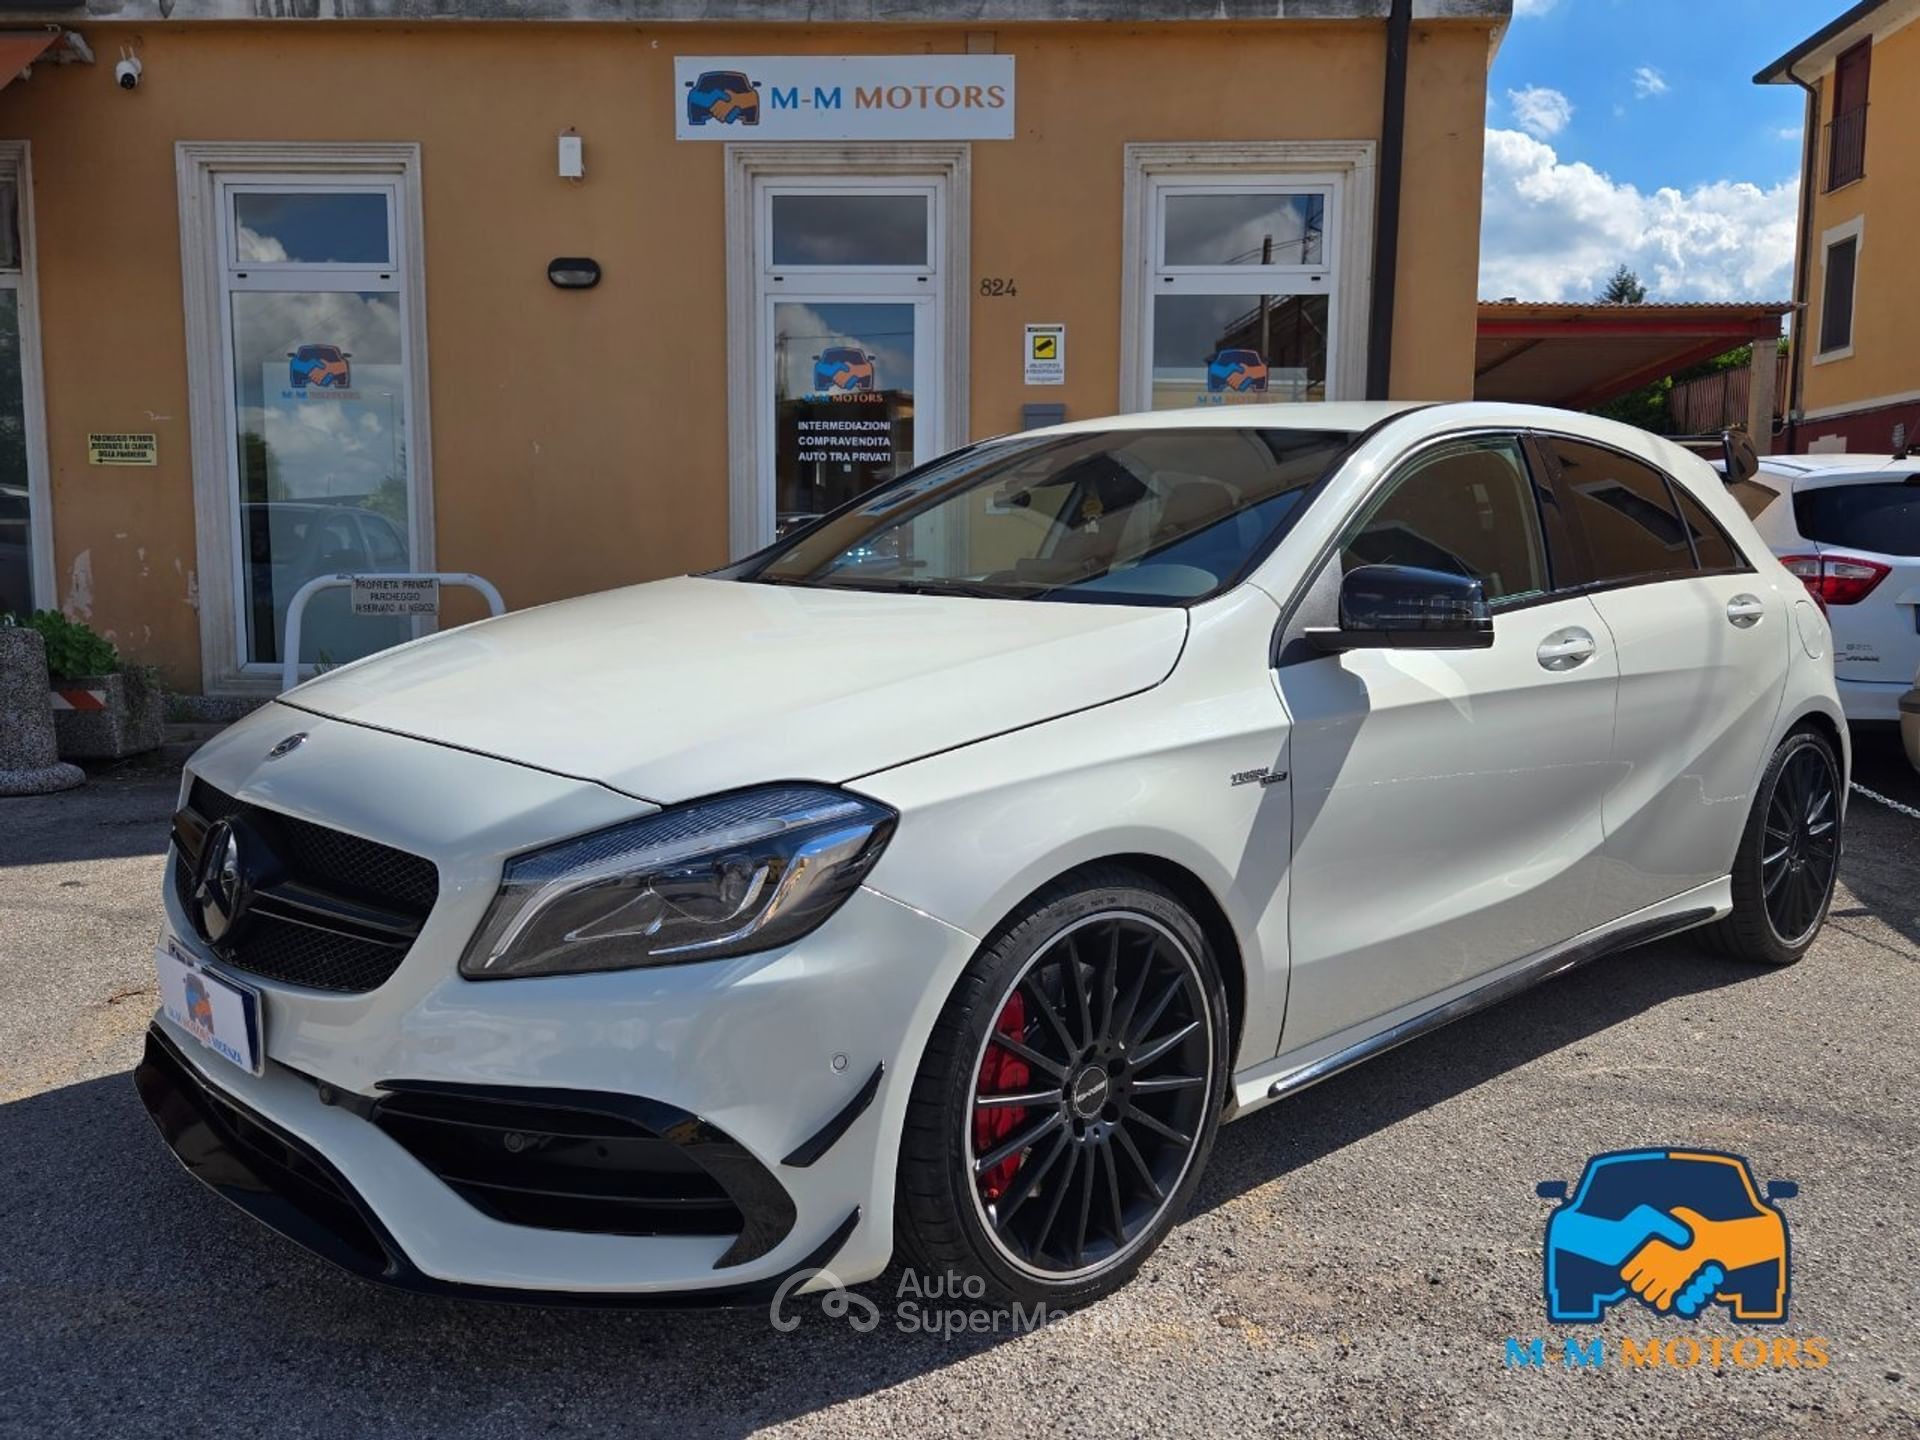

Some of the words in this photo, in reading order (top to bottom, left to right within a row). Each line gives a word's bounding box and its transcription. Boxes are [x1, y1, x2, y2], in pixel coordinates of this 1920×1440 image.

[771, 86, 842, 110] M-M
[855, 85, 1006, 109] MOTORS
[980, 278, 1017, 297] 824
[832, 394, 883, 403] MOTORS
[798, 421, 891, 431] INTERMEDIAZIONI
[798, 436, 891, 446] COMPRAVENDITA
[798, 452, 828, 462] AUTO
[829, 452, 850, 462] TRA
[852, 452, 891, 462] PRIVATI
[370, 592, 421, 601] PARCHEGGIO
[355, 603, 395, 613] RISERVATO
